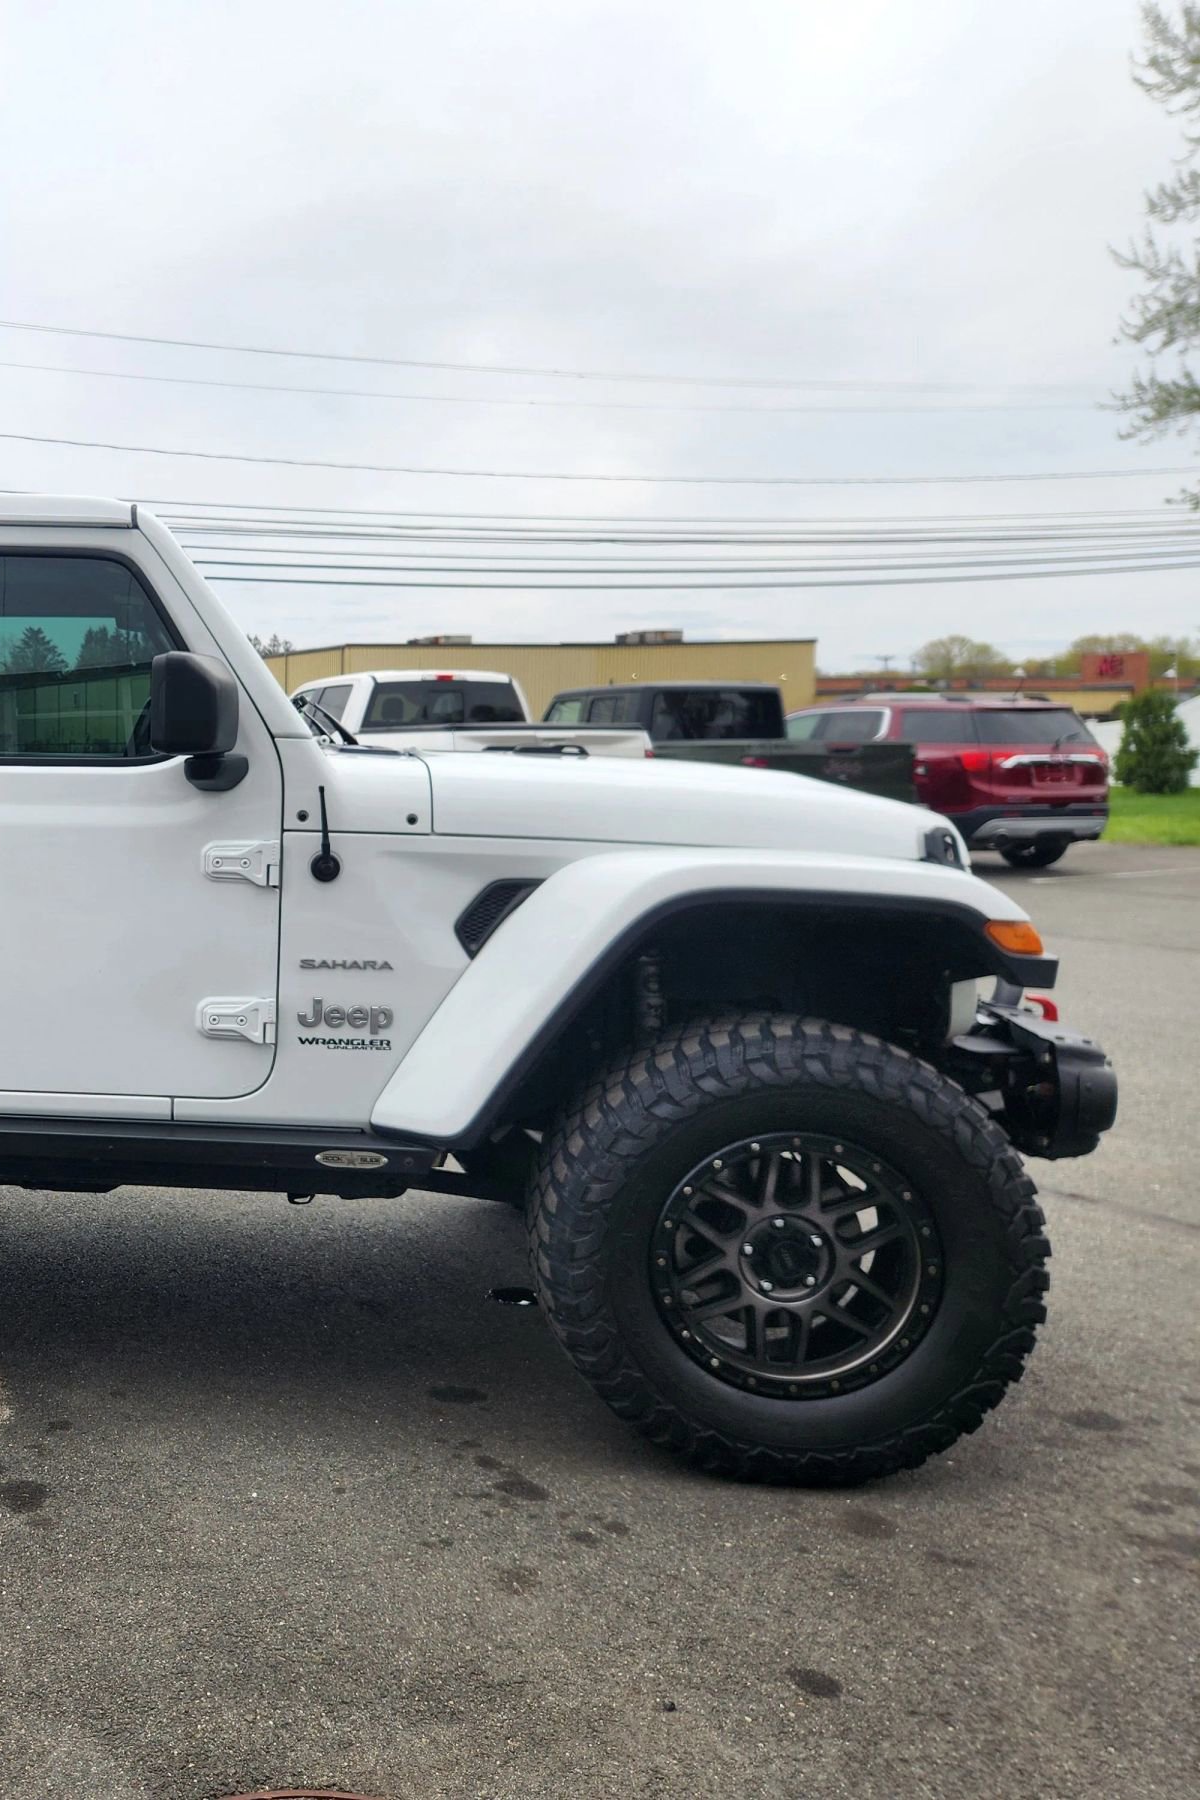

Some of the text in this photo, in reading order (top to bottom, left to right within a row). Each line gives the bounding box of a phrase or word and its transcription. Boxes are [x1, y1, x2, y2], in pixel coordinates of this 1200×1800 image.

[299, 959, 393, 970] SAHARA
[297, 997, 393, 1035] Jeep
[298, 1036, 391, 1046] WRANGLER
